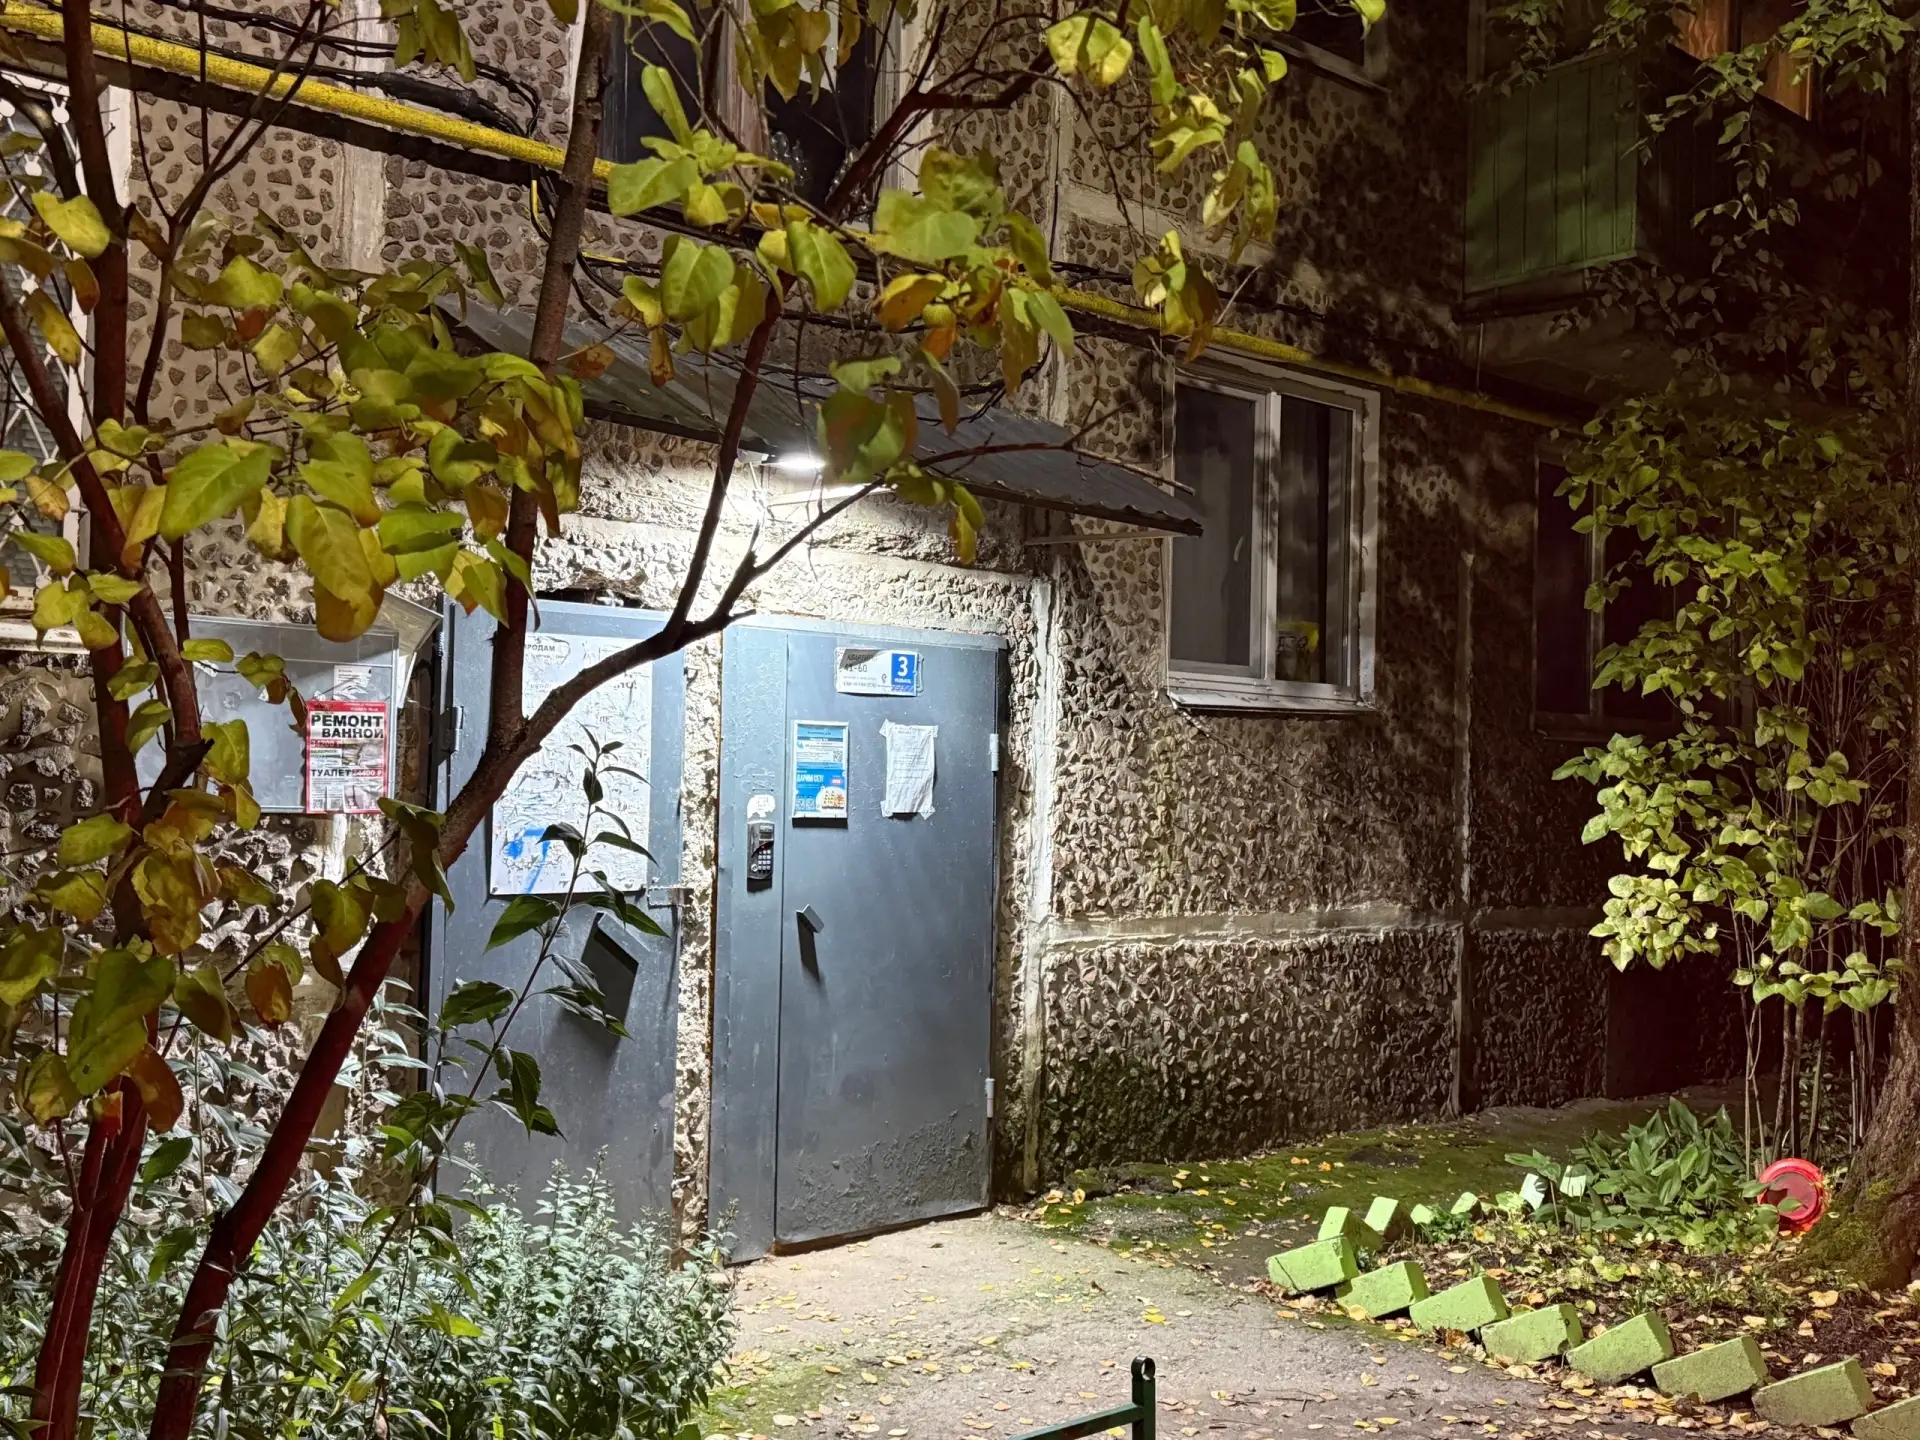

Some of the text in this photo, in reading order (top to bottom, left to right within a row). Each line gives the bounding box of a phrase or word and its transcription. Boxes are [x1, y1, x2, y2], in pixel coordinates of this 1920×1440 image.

[844, 664, 868, 673] 41-60
[897, 656, 908, 677] 3
[311, 714, 384, 727] РЕМОНТ
[322, 727, 384, 739] ВАННОЙ
[311, 769, 352, 777] ТУАЛЕТ
